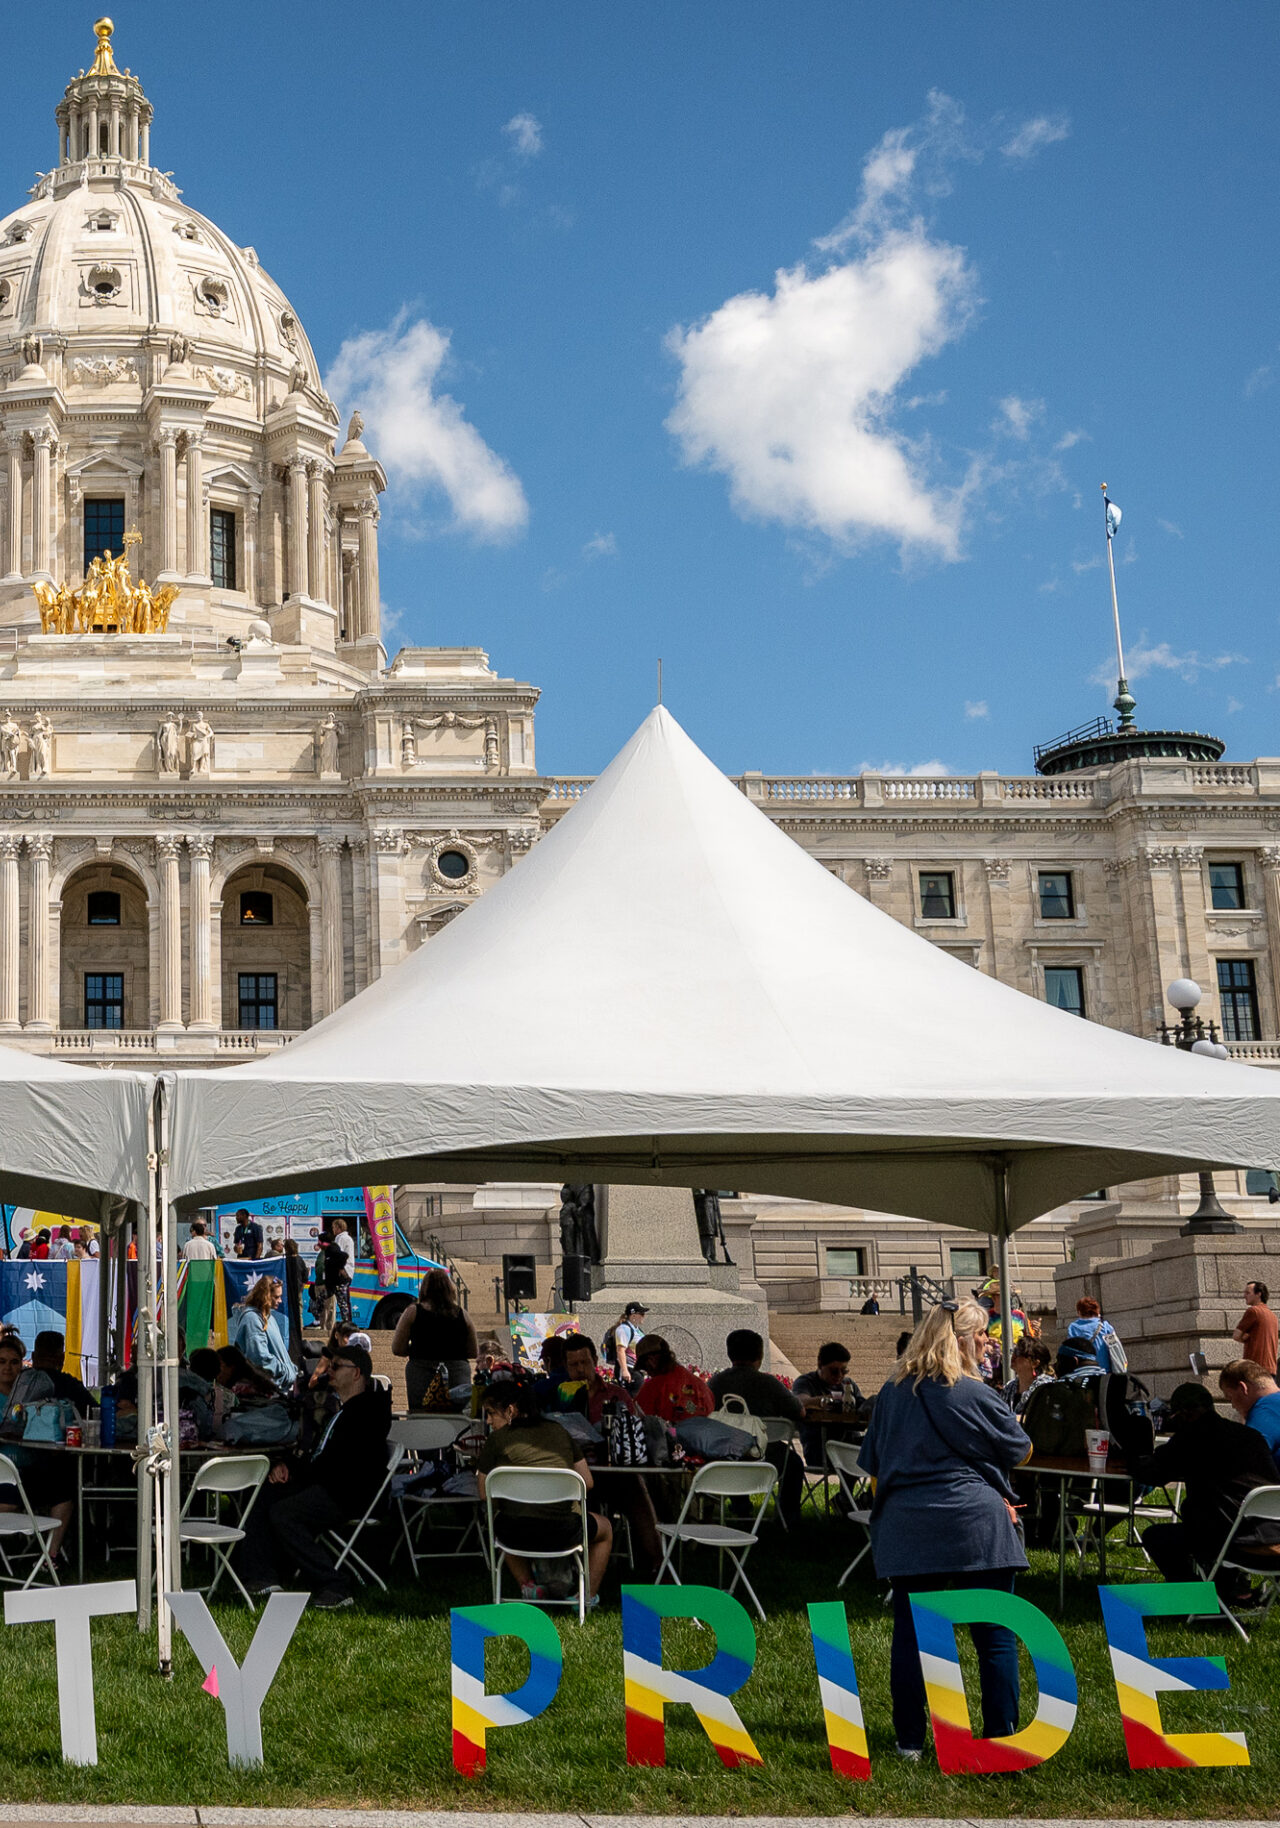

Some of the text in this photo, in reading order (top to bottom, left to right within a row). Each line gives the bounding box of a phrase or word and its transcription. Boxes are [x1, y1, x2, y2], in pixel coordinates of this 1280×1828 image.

[262, 1201, 309, 1214] Be Happy
[451, 1581, 1251, 1781] PRIDE
